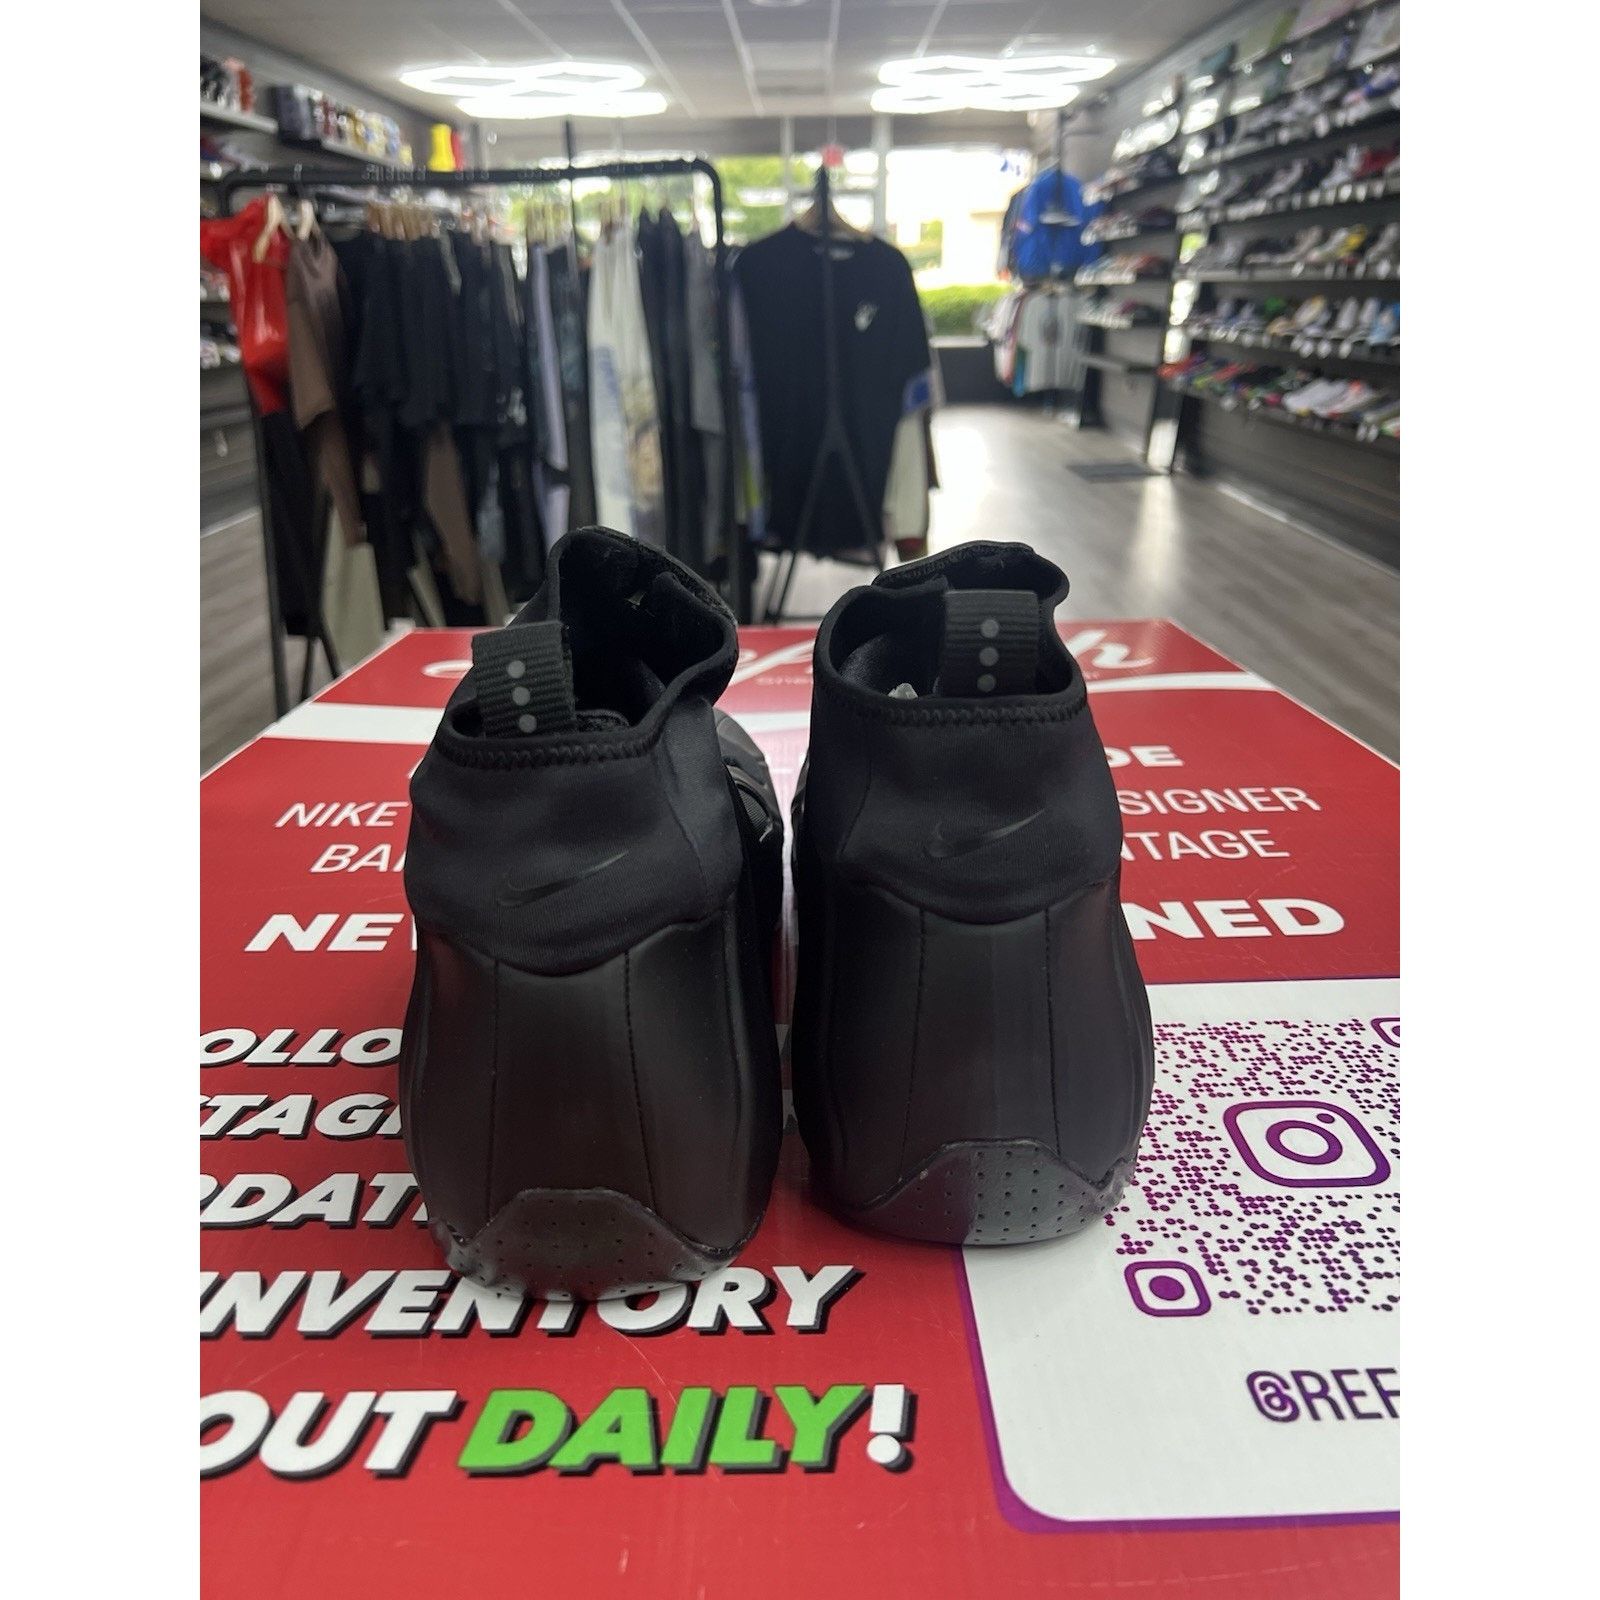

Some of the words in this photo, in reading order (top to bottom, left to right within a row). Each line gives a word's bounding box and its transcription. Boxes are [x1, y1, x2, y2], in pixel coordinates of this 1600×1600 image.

[274, 801, 411, 828] NIKE
[1116, 786, 1321, 815] SIGNER
[310, 843, 407, 873] BA
[244, 913, 418, 952] NE
[1120, 898, 1345, 941] NED
[200, 1092, 403, 1138] TAG
[200, 1172, 429, 1227] DAT
[200, 1264, 855, 1336] NVENORY
[456, 1383, 912, 1474] DAILY!
